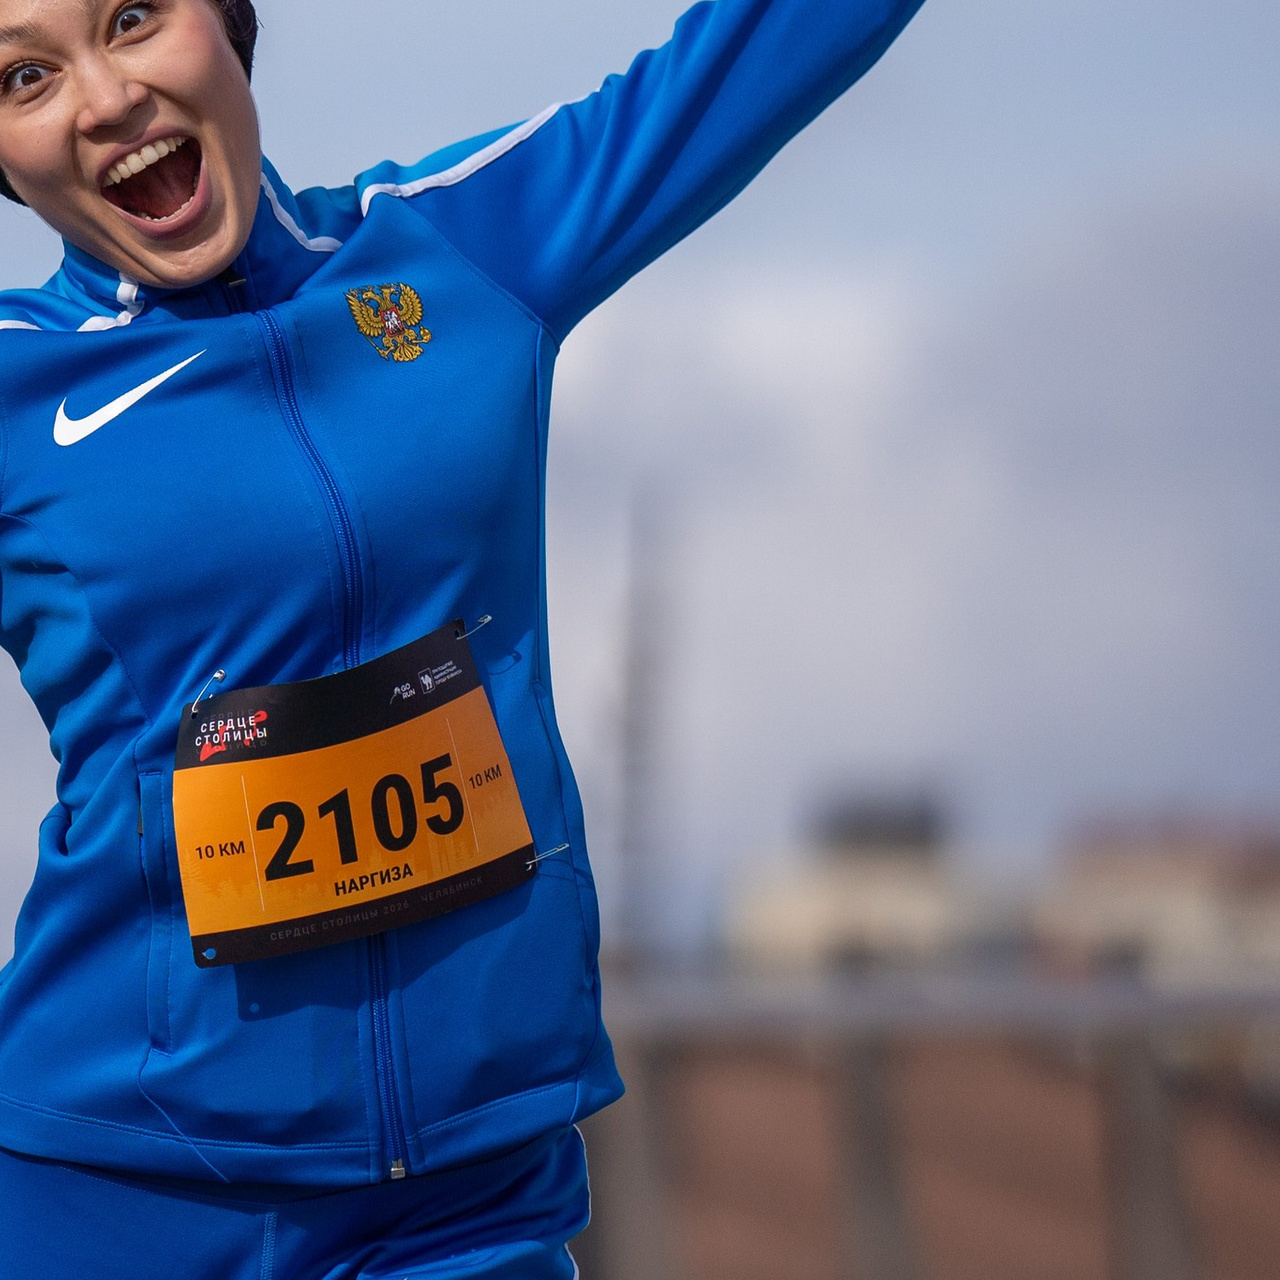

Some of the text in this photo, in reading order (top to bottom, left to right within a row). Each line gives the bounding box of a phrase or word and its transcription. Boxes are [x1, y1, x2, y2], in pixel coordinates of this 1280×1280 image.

[401, 683, 411, 692] GO
[402, 688, 416, 699] RUN
[201, 715, 256, 733] СЕРДЦЕ
[195, 727, 267, 746] СТОЛИЦЫ
[469, 773, 483, 789] 10
[256, 753, 465, 882] 2105
[195, 845, 214, 859] 10
[334, 863, 413, 896] НАРГИЗА
[270, 876, 483, 941] СЕРДЦЕ СТОЛИЦЫ 2026 ЧЕЛЯБИНСК
